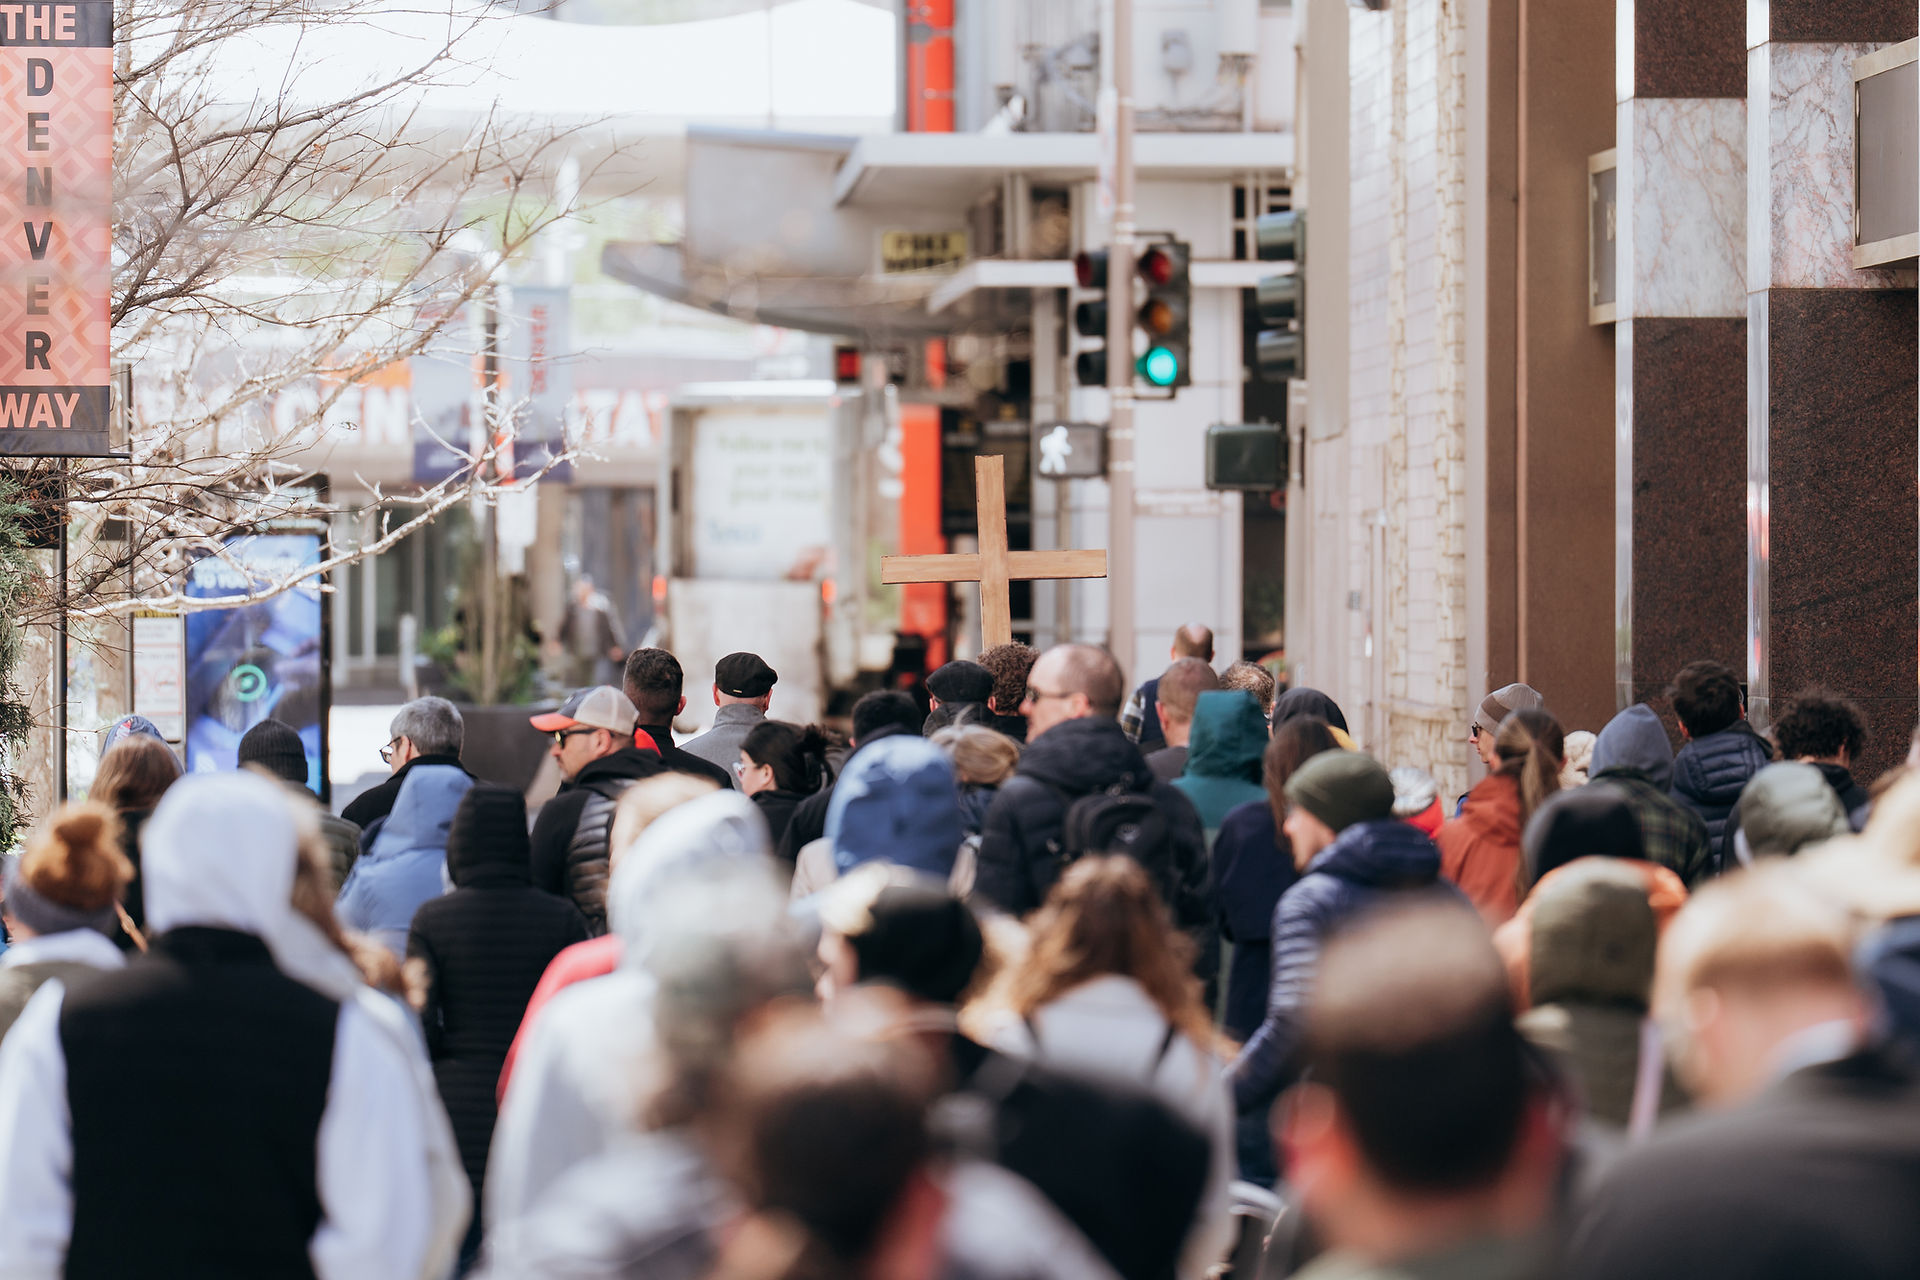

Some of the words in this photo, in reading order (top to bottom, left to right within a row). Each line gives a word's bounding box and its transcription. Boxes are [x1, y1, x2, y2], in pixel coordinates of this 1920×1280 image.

[0, 5, 76, 40] THE
[24, 58, 54, 370] DENVER
[0, 393, 80, 428] WAY
